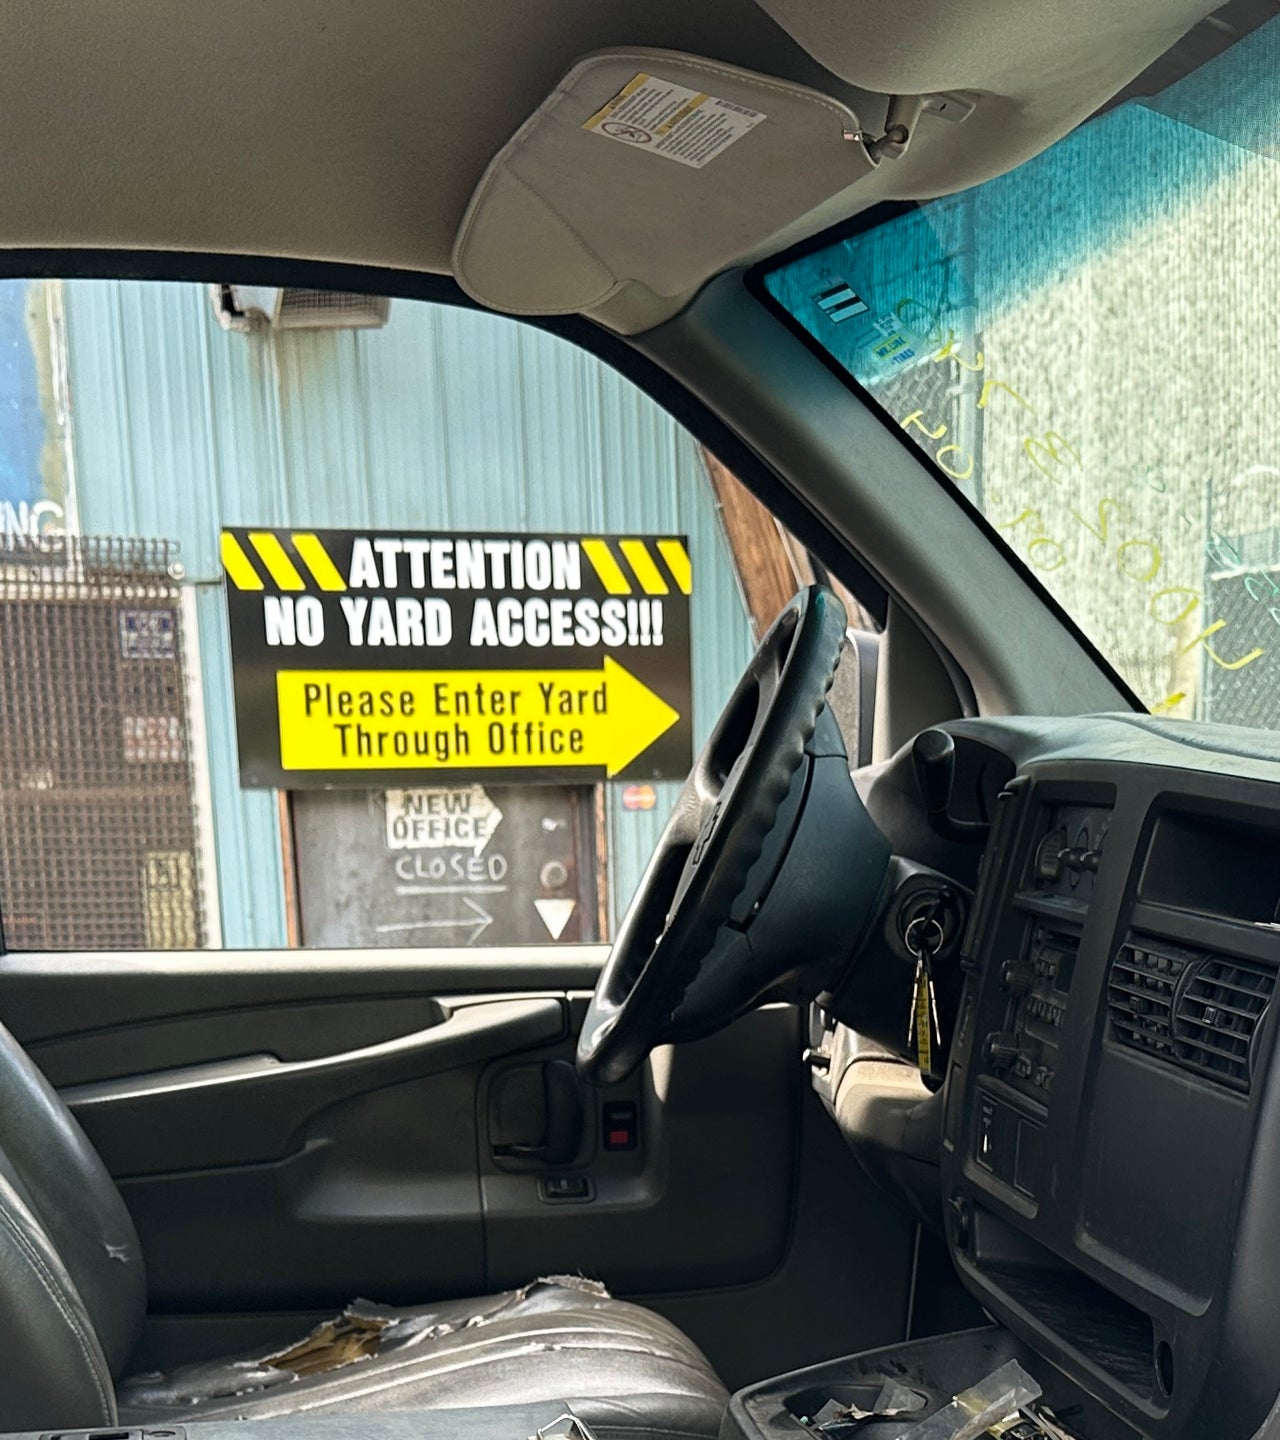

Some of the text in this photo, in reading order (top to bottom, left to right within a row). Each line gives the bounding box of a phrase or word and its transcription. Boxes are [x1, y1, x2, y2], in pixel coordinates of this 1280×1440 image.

[349, 537, 582, 590] ATTENTION
[264, 596, 663, 648] NO YARD ACCESS!!!
[304, 681, 608, 718] Please Enter Yard
[333, 722, 585, 761] Through Office
[405, 793, 472, 816] NEW
[392, 815, 489, 841] OFFICE
[395, 853, 509, 882] CLOSED
